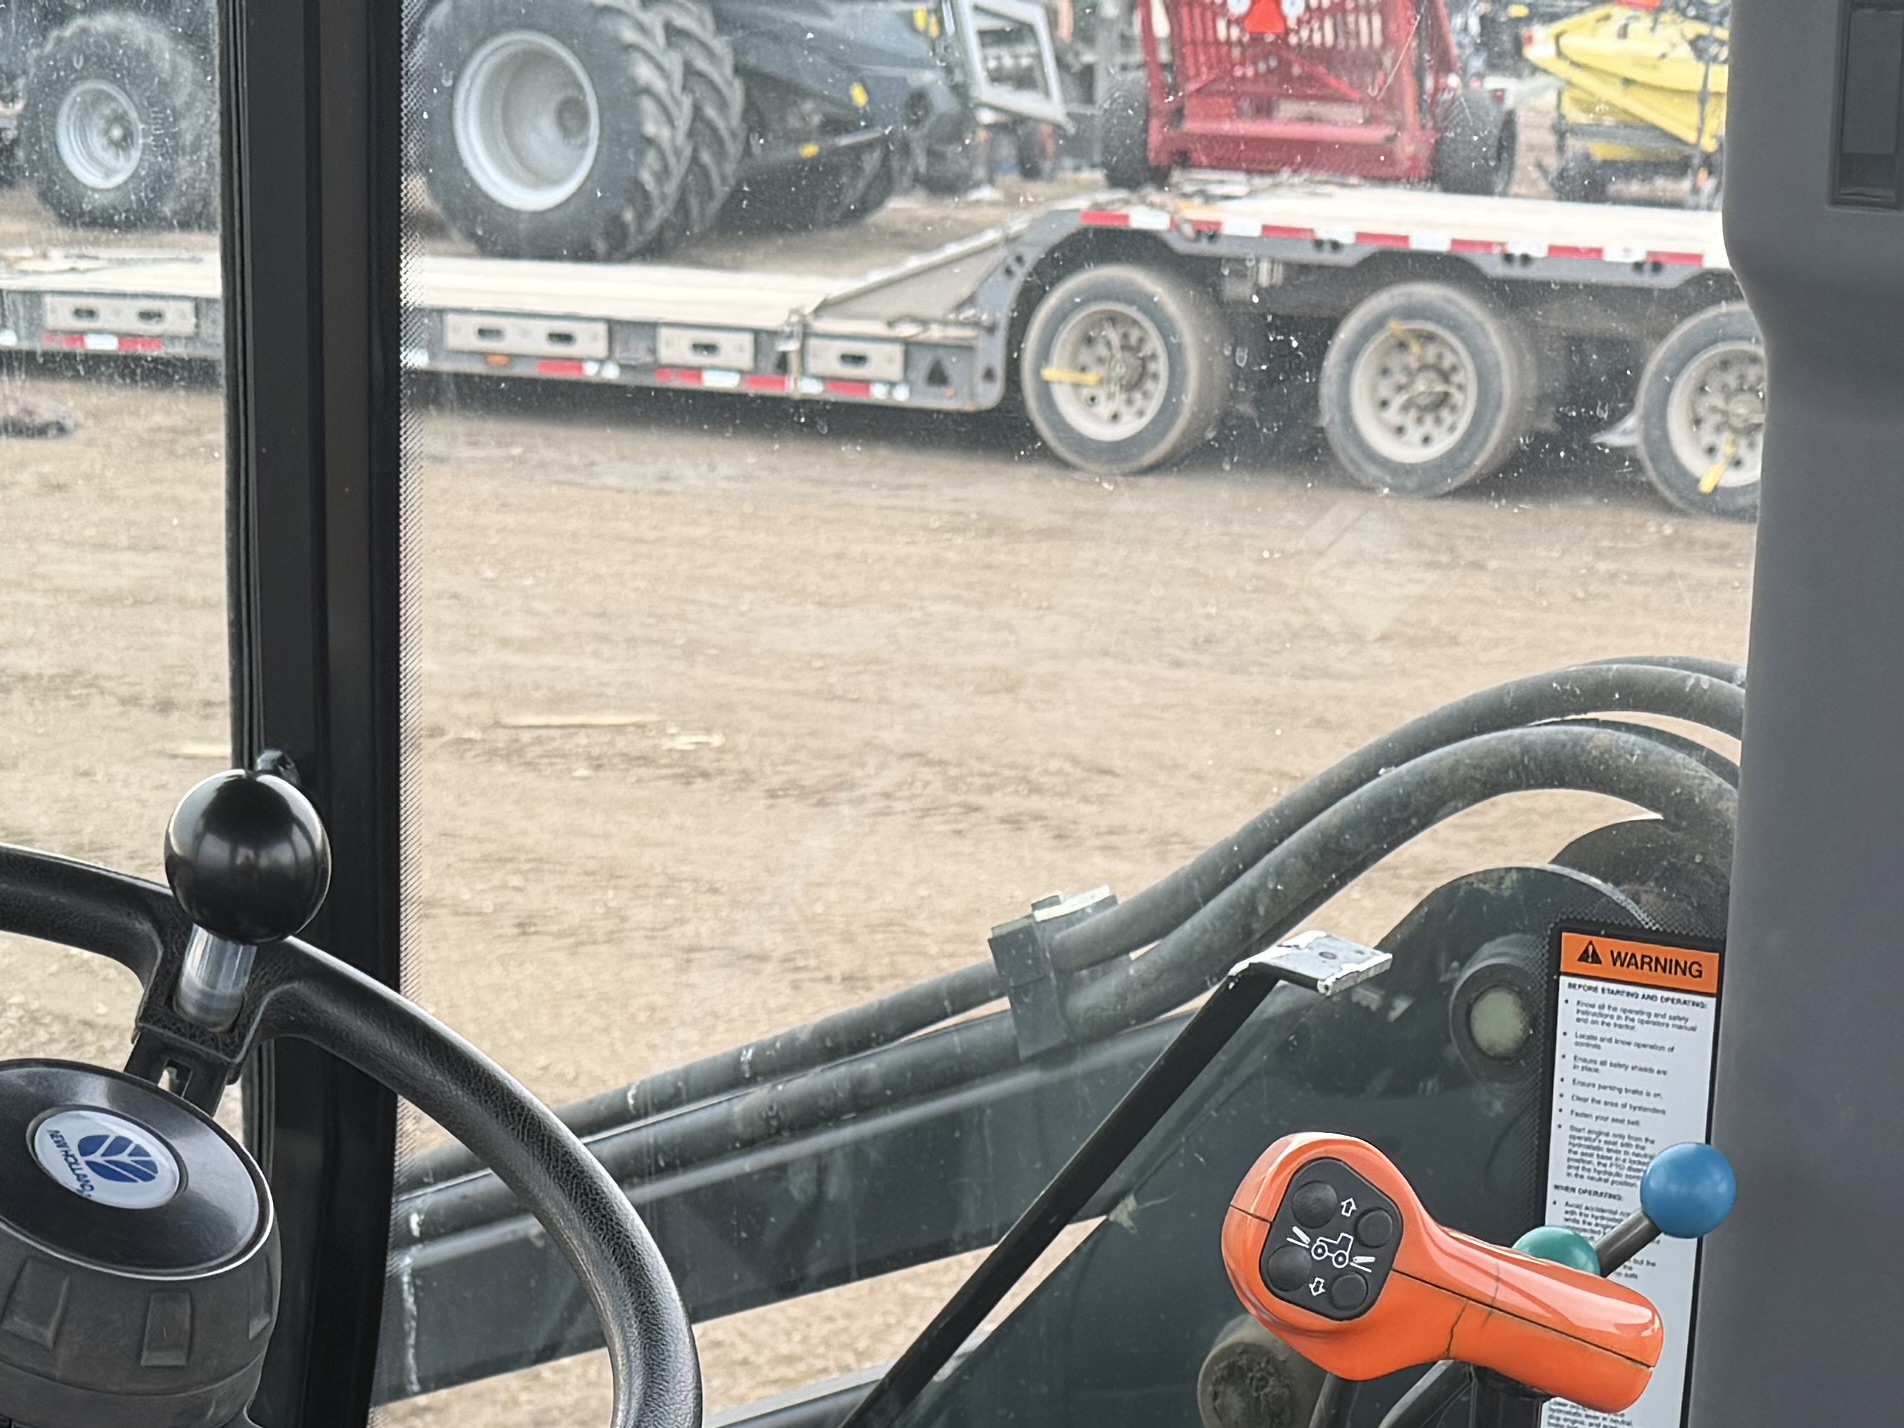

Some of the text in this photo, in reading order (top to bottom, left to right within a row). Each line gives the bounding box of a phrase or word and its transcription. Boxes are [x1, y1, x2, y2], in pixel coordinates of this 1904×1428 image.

[1610, 950, 1704, 978] WARNING
[1568, 982, 1598, 993] BEFORE
[1601, 987, 1639, 999] STARTING
[1641, 992, 1658, 1001] AND
[61, 1148, 95, 1194] HOLLAND
